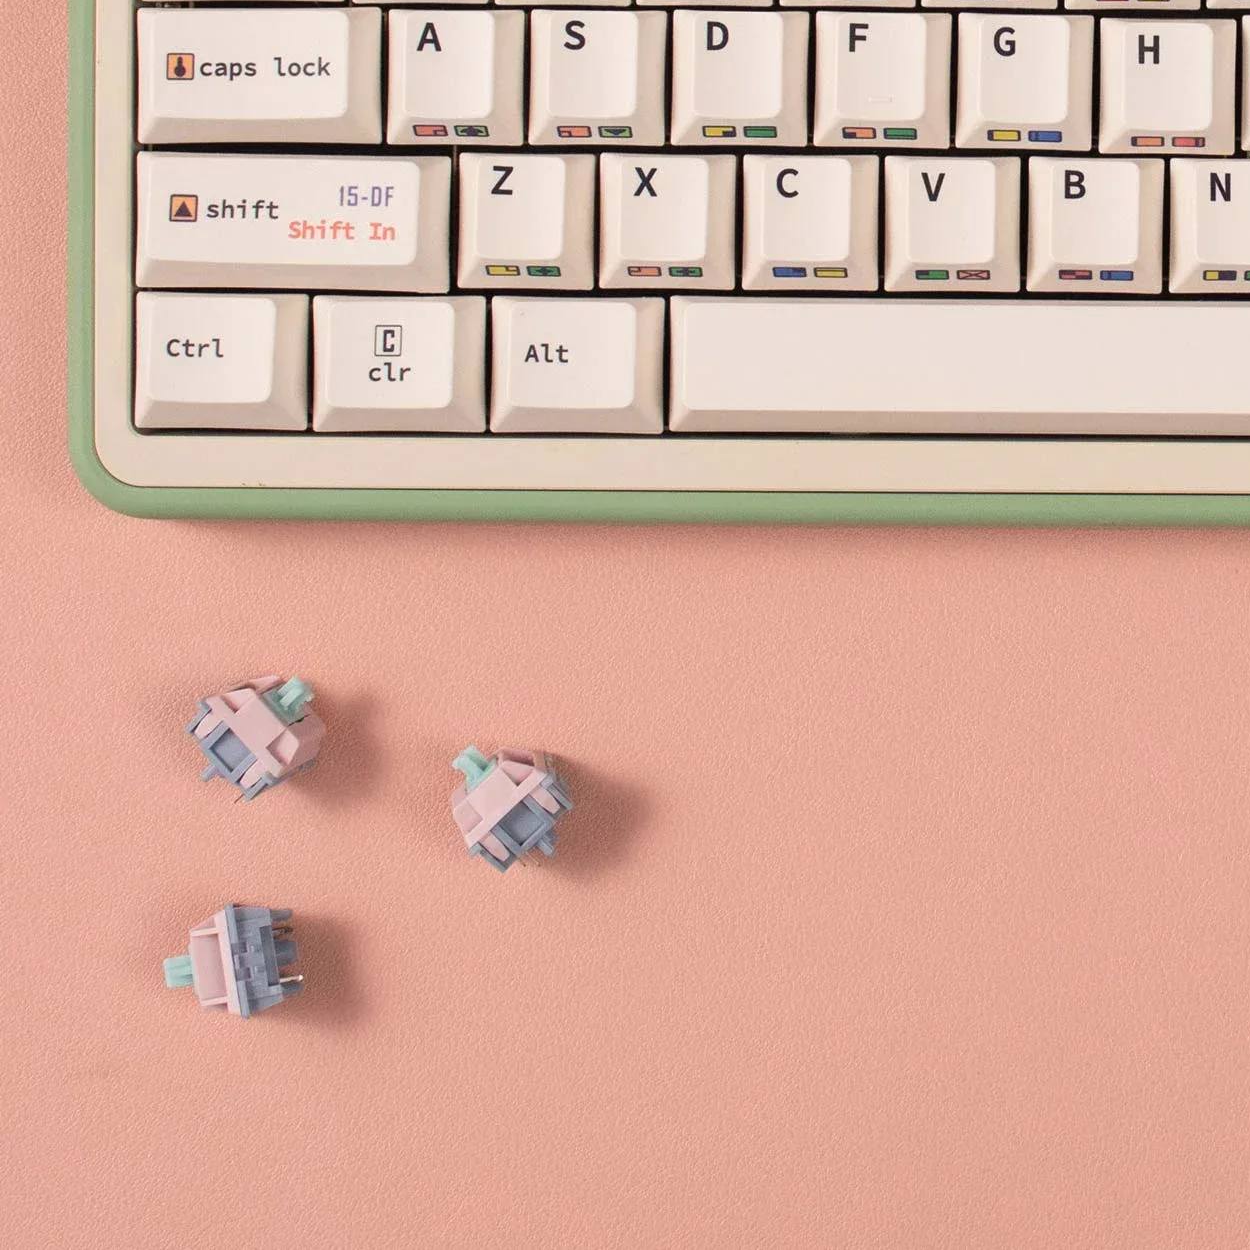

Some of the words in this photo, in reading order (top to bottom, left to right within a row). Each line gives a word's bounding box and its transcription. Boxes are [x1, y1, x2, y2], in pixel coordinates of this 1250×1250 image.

[416, 21, 442, 52] A
[563, 20, 586, 51] S
[706, 20, 730, 51] D
[848, 22, 869, 53] F
[993, 26, 1016, 57] G
[1138, 34, 1160, 65] H
[199, 62, 257, 81] caps
[273, 56, 331, 77] lock
[339, 185, 395, 207] 15-DF
[490, 165, 514, 196] Z
[633, 166, 658, 198] X
[775, 168, 799, 199] C
[920, 171, 946, 202] V
[1064, 169, 1087, 200] B
[1209, 172, 1232, 202] N
[206, 198, 279, 220] shift
[287, 219, 355, 241] Shift
[369, 222, 396, 241] In
[166, 338, 224, 358] Ctrl
[382, 329, 396, 353] C
[524, 343, 569, 364] Alt
[368, 361, 412, 382] clr
